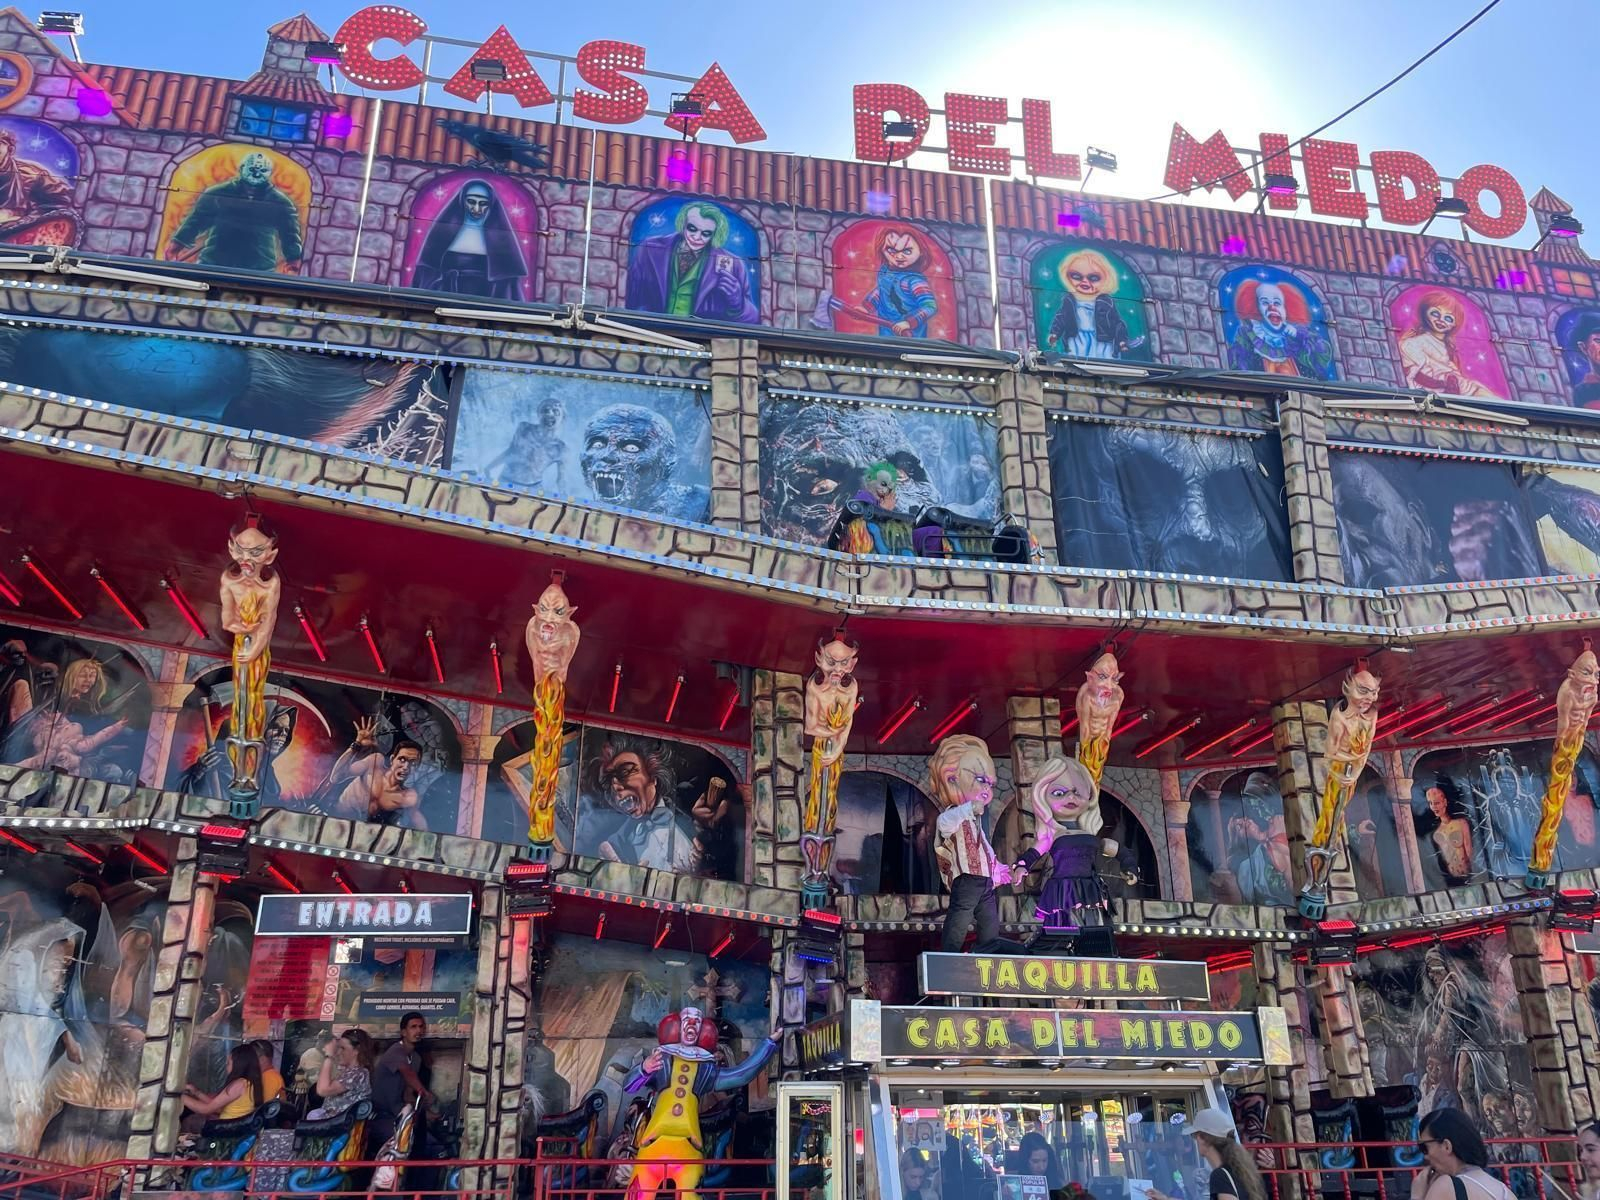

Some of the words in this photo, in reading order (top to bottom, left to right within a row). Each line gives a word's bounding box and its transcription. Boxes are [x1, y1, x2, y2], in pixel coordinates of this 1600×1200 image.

[334, 4, 767, 145] CASA
[853, 83, 1081, 181] DEL
[1163, 121, 1528, 239] MIEDO
[298, 900, 433, 928] ENTRADA
[976, 958, 1159, 993] TAQUILLA
[802, 1022, 841, 1064] TAQUILLA
[906, 1017, 1011, 1049] CASA
[1031, 1018, 1100, 1049] DEL
[1120, 1018, 1243, 1051] MIEDO
